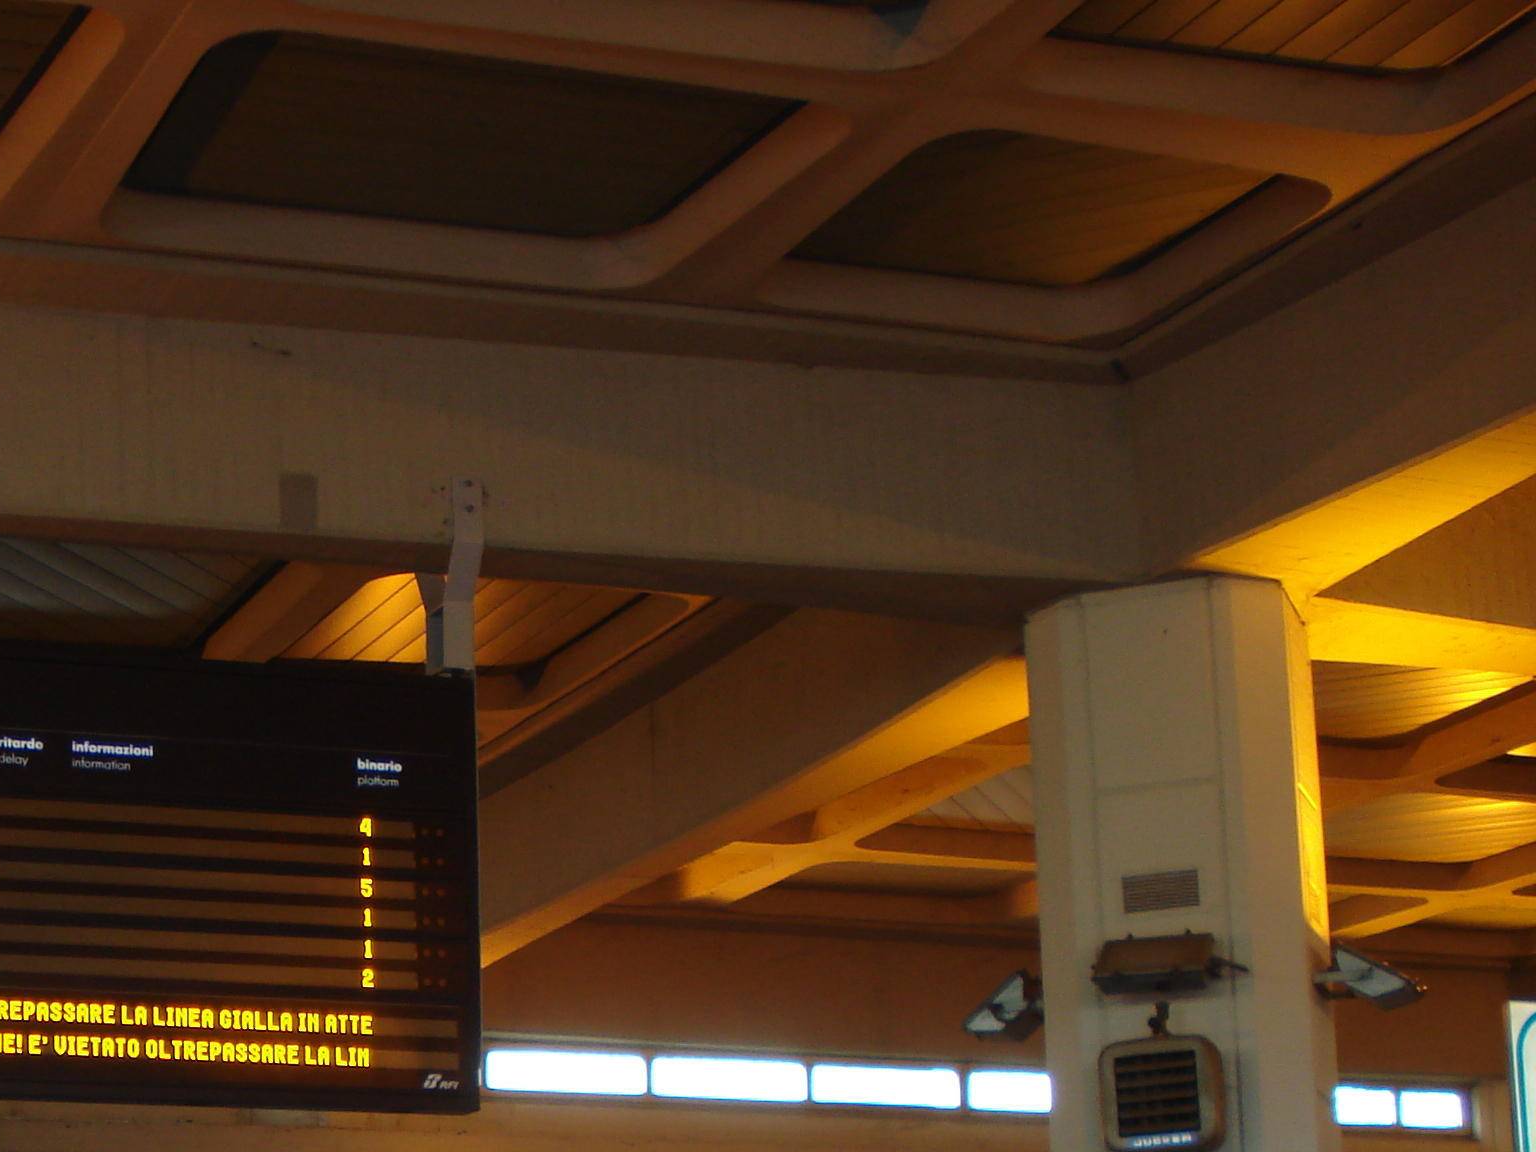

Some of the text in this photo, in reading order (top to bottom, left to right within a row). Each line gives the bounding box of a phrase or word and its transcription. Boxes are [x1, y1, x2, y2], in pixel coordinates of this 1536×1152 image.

[71, 740, 154, 757] informazioni
[72, 755, 132, 771] information
[356, 757, 403, 773] binario
[357, 775, 400, 788] platform
[359, 817, 372, 837] 4
[362, 847, 371, 866] 1
[360, 878, 373, 898] 5
[363, 907, 372, 927] 1
[364, 939, 373, 959] 1
[361, 968, 375, 988] 2
[121, 1004, 148, 1026] LA
[152, 1006, 215, 1029] LINEA
[219, 1008, 294, 1032] GIALLA
[297, 1012, 320, 1033] IN
[324, 1013, 373, 1034] ATTE
[28, 1033, 49, 1055] E'
[53, 1034, 141, 1058] VIETATO
[145, 1038, 301, 1065] OLTREPASSARE
[304, 1045, 331, 1066] LA
[335, 1046, 370, 1068] LIN
